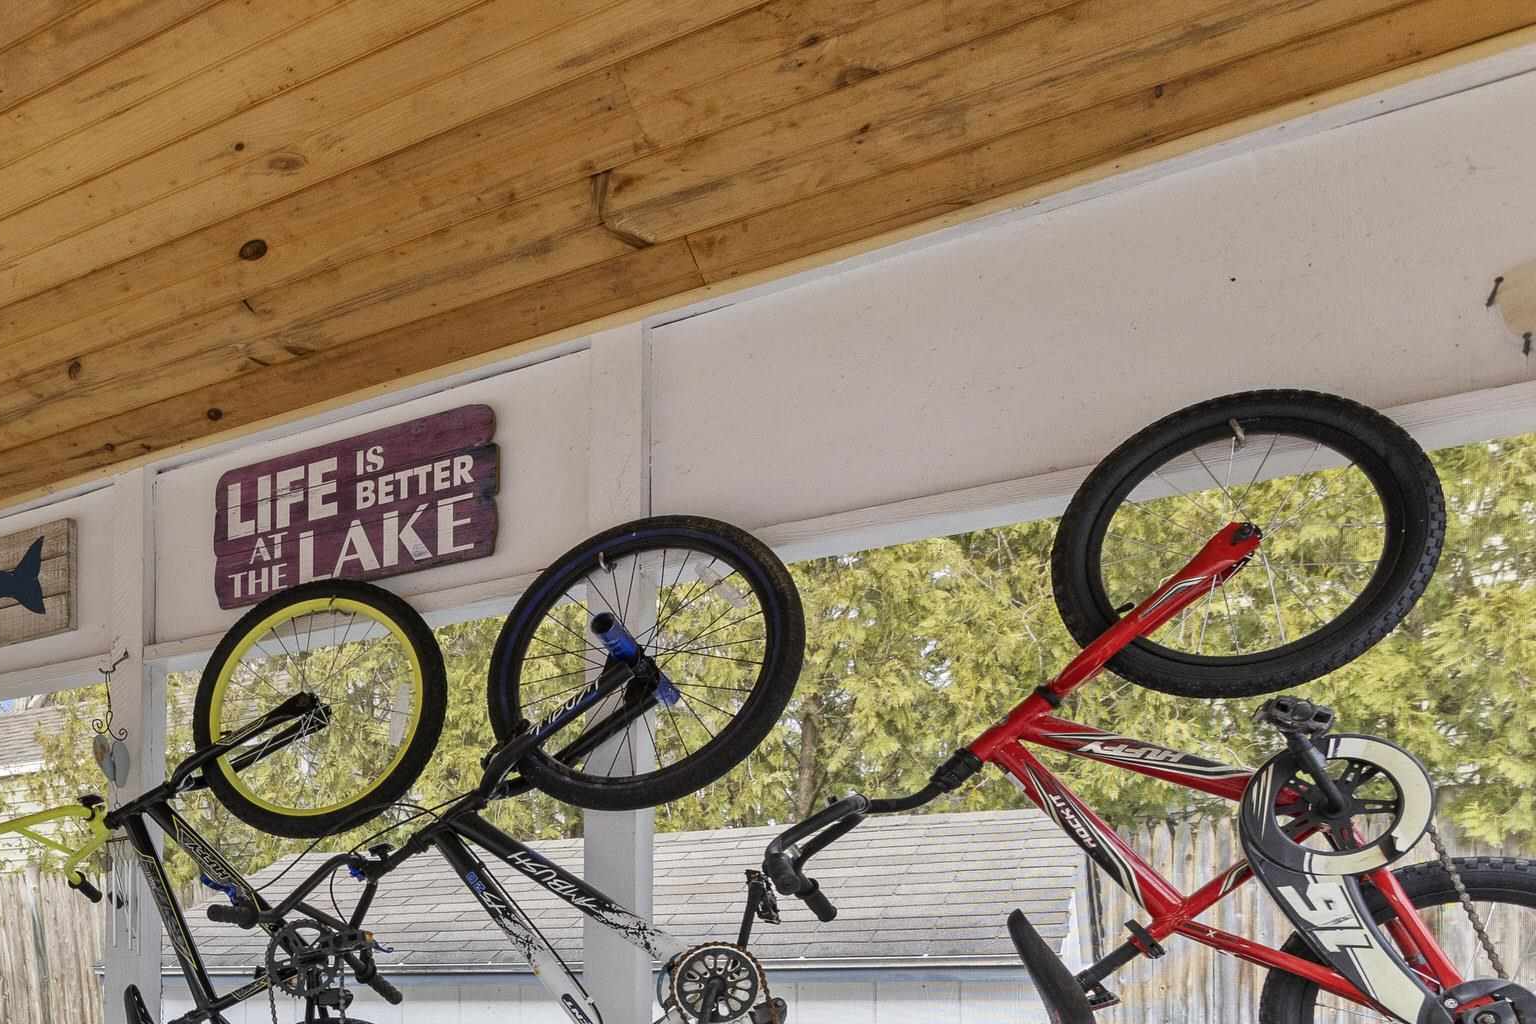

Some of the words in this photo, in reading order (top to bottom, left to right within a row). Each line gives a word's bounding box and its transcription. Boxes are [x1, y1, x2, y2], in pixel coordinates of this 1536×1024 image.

[227, 456, 338, 541] LIFE
[355, 445, 385, 476] IS
[355, 454, 475, 510] BETTER
[228, 563, 288, 598] THE
[299, 492, 475, 585] LAKE
[249, 531, 288, 565] AT
[1076, 740, 1187, 764] HUFFY
[184, 841, 231, 880] HUFFY
[506, 850, 604, 917] AMBUSH
